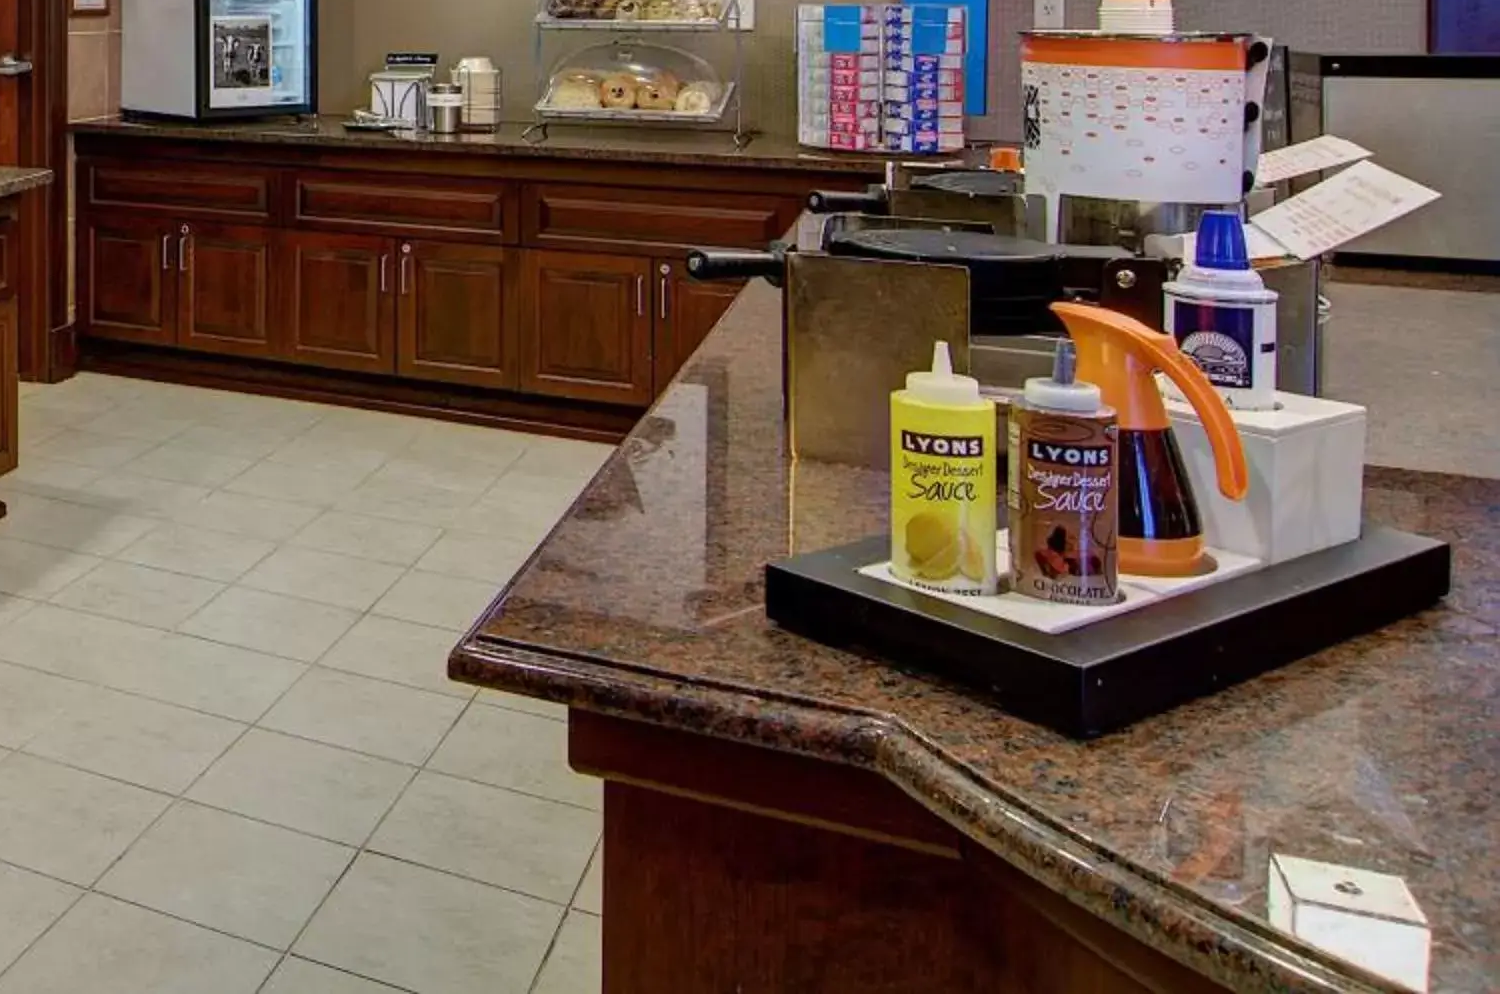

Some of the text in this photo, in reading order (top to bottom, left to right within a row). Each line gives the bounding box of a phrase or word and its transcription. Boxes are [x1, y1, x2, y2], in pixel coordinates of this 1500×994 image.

[905, 434, 980, 455] LYONS
[1032, 443, 1108, 464] LYONS
[906, 473, 977, 502] Sauce
[1034, 483, 1105, 511] Sauce
